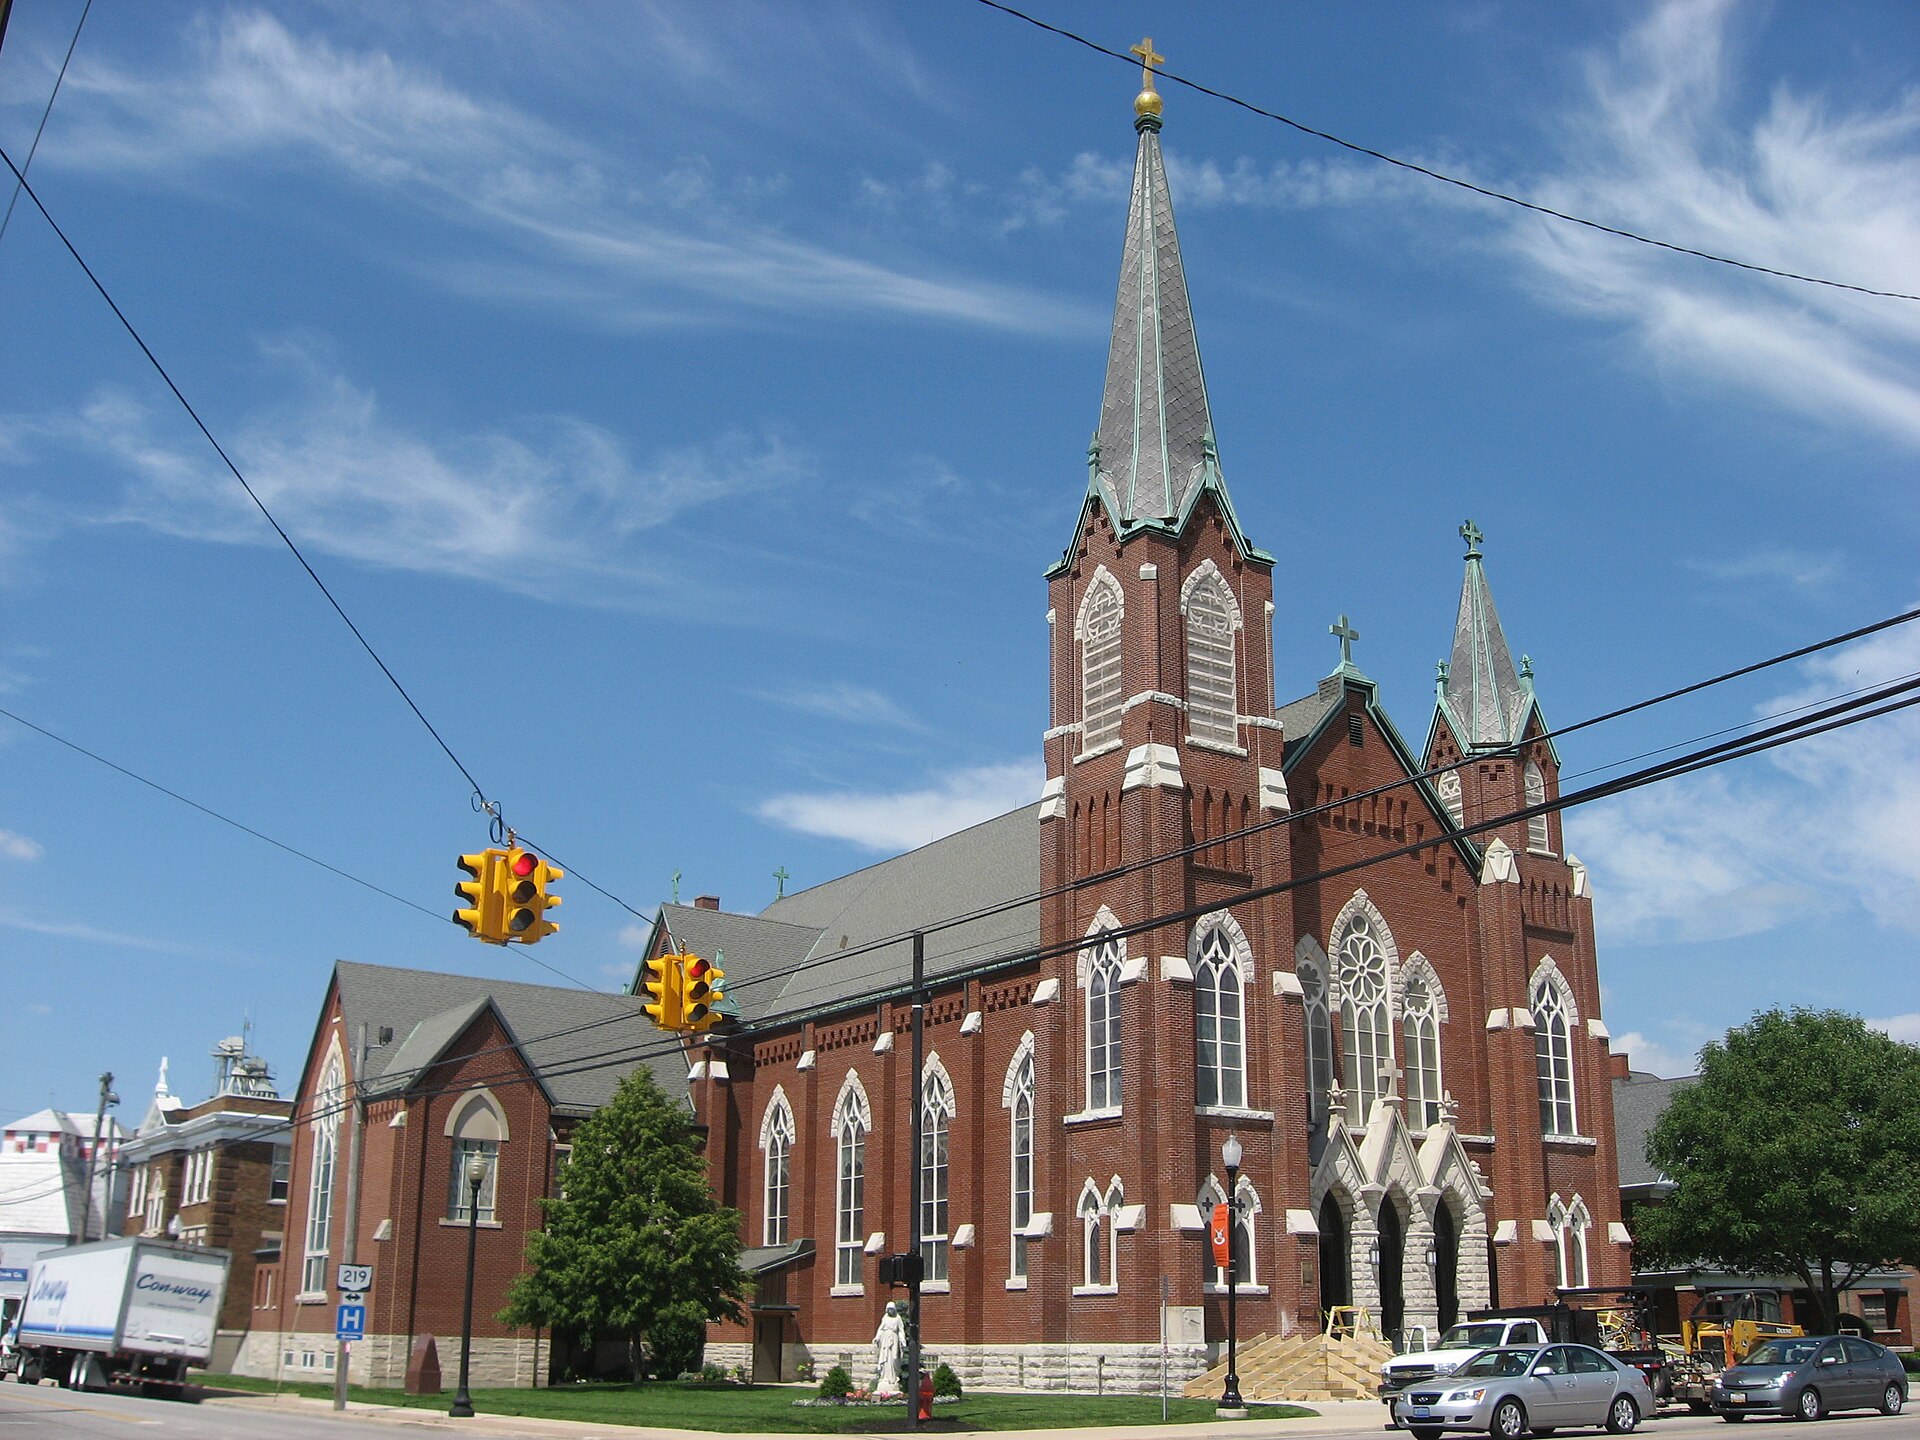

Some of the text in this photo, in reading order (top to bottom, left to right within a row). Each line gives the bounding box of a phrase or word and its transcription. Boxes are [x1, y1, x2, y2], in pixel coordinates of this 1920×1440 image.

[343, 1270, 367, 1283] 219
[136, 1273, 212, 1304] Con-way
[342, 1309, 360, 1330] H
